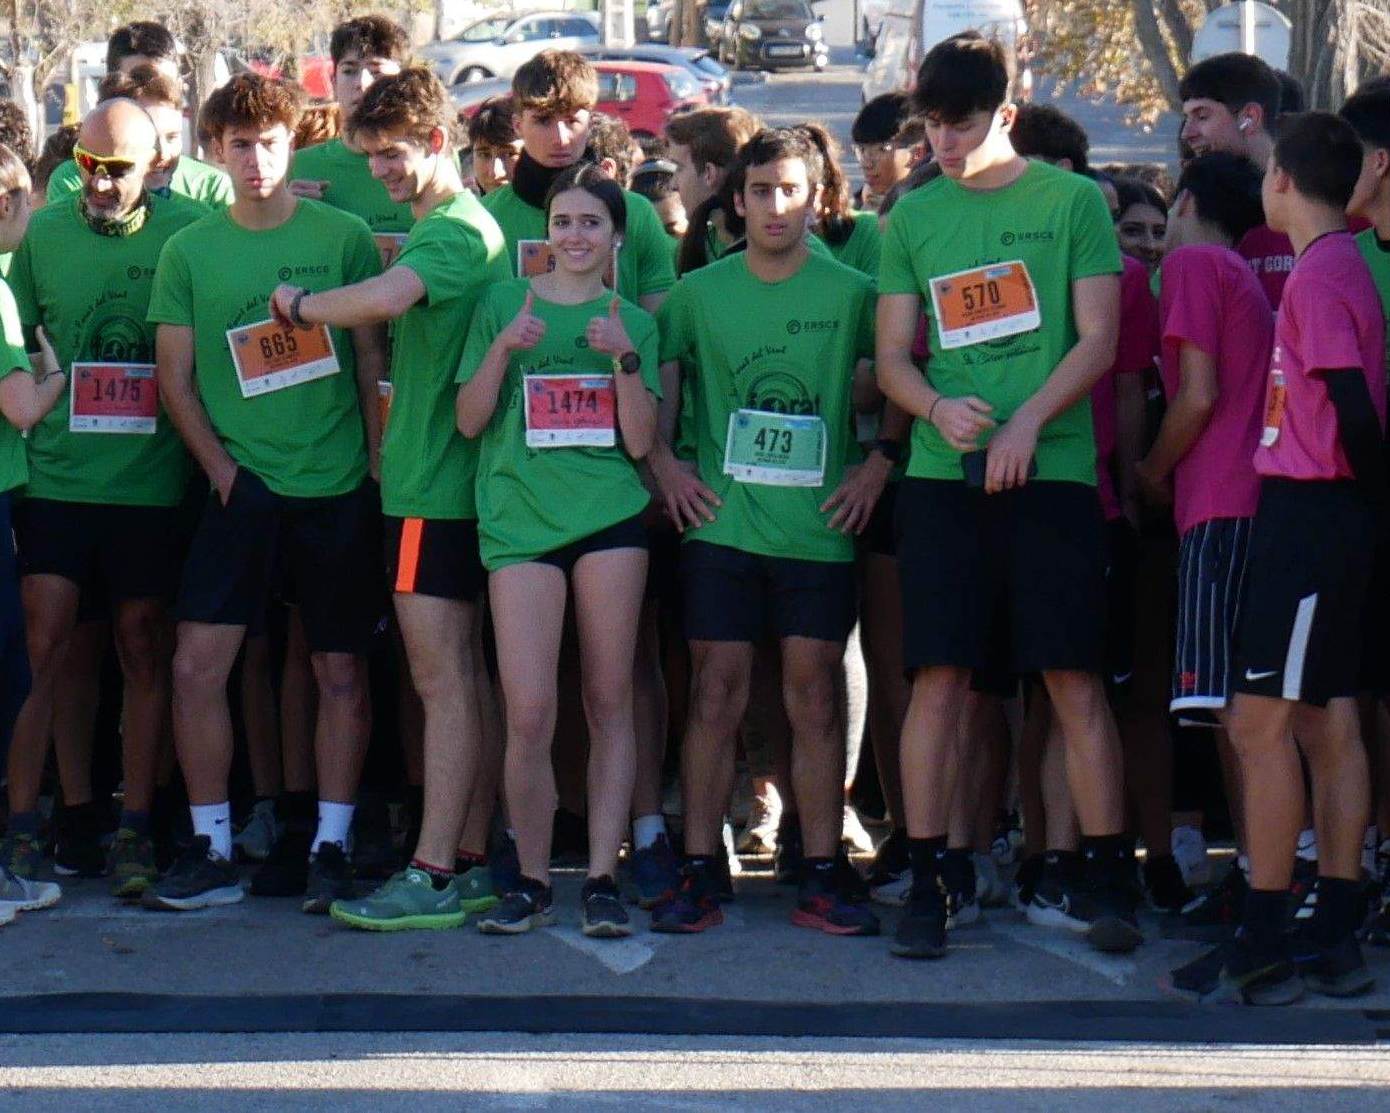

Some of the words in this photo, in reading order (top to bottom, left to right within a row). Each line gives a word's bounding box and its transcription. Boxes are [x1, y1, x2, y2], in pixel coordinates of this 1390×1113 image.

[962, 280, 999, 310] 570
[93, 378, 142, 402] 1475
[547, 390, 597, 414] 1474
[754, 428, 793, 453] 473
